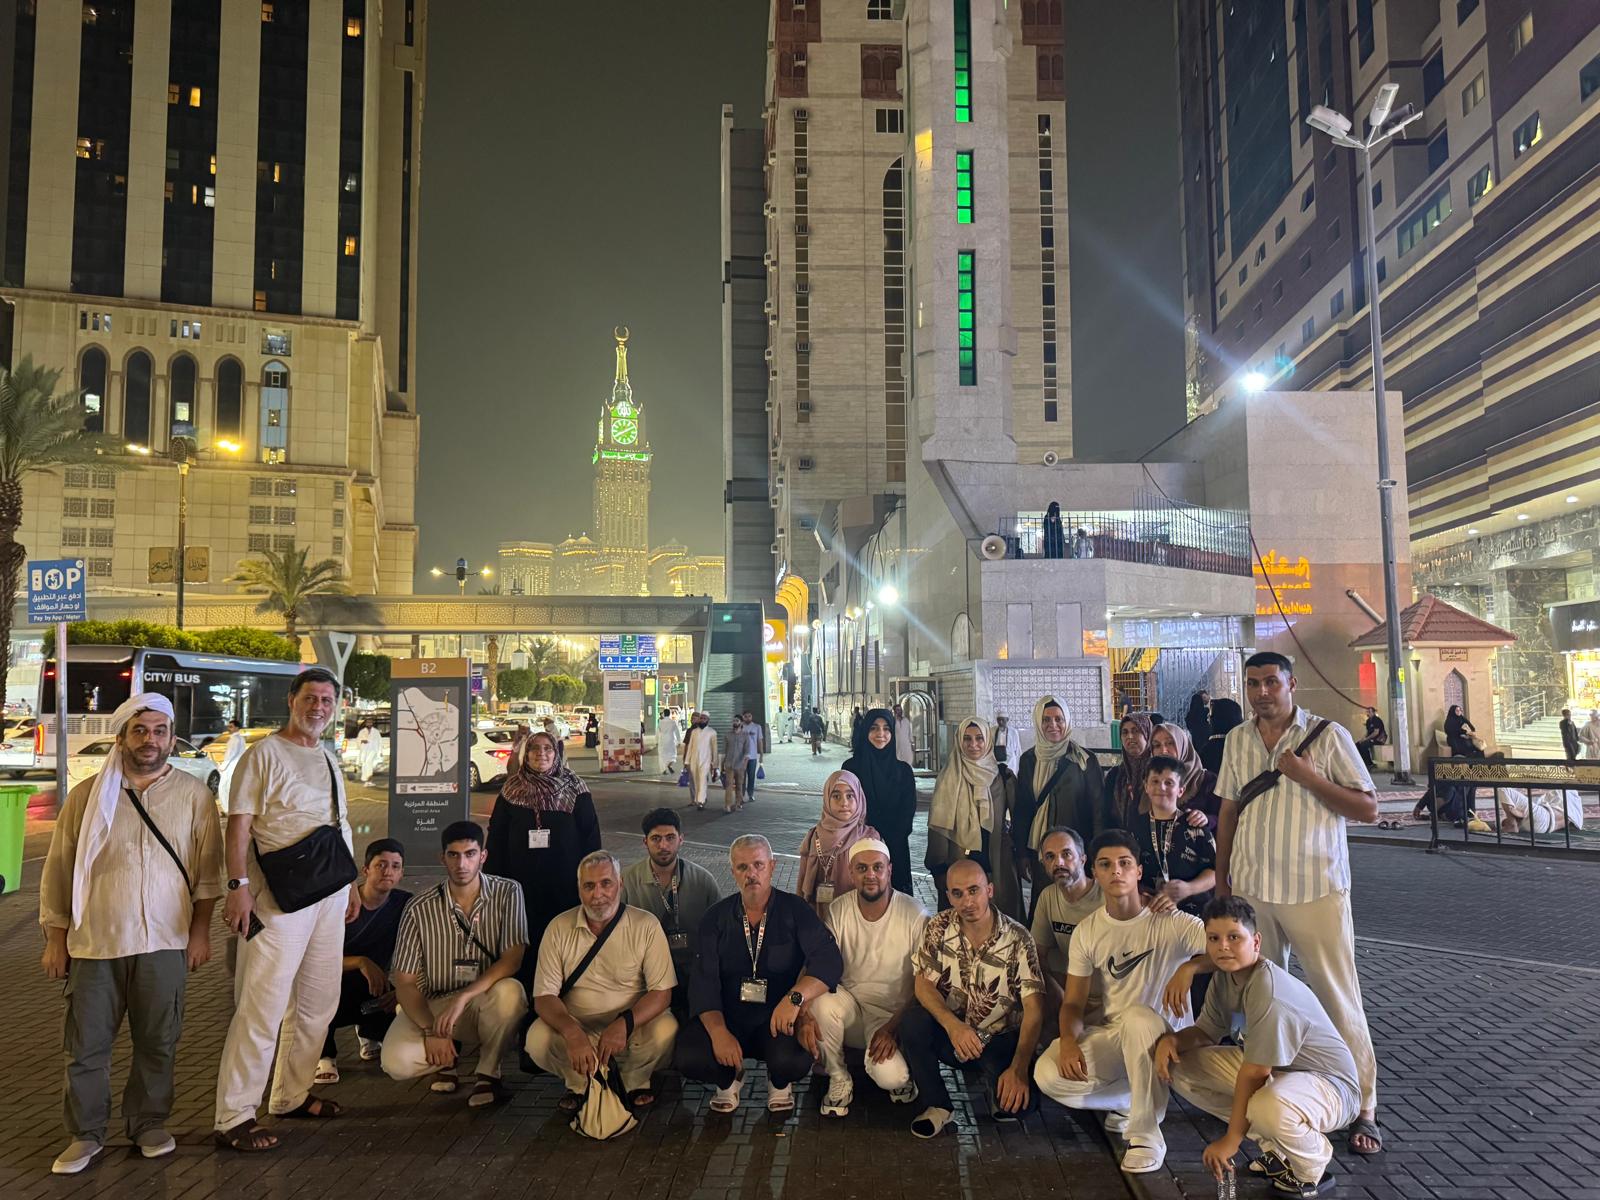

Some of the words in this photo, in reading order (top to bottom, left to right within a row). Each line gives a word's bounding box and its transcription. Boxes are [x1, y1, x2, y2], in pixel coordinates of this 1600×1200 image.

[66, 568, 81, 590] P
[32, 593, 56, 603] التطبيق
[56, 594, 67, 602] عبر
[68, 593, 81, 601] ادفع
[34, 603, 59, 611] المواقف
[421, 663, 437, 674] B2
[174, 674, 200, 684] BUS
[416, 818, 435, 826] الغزة
